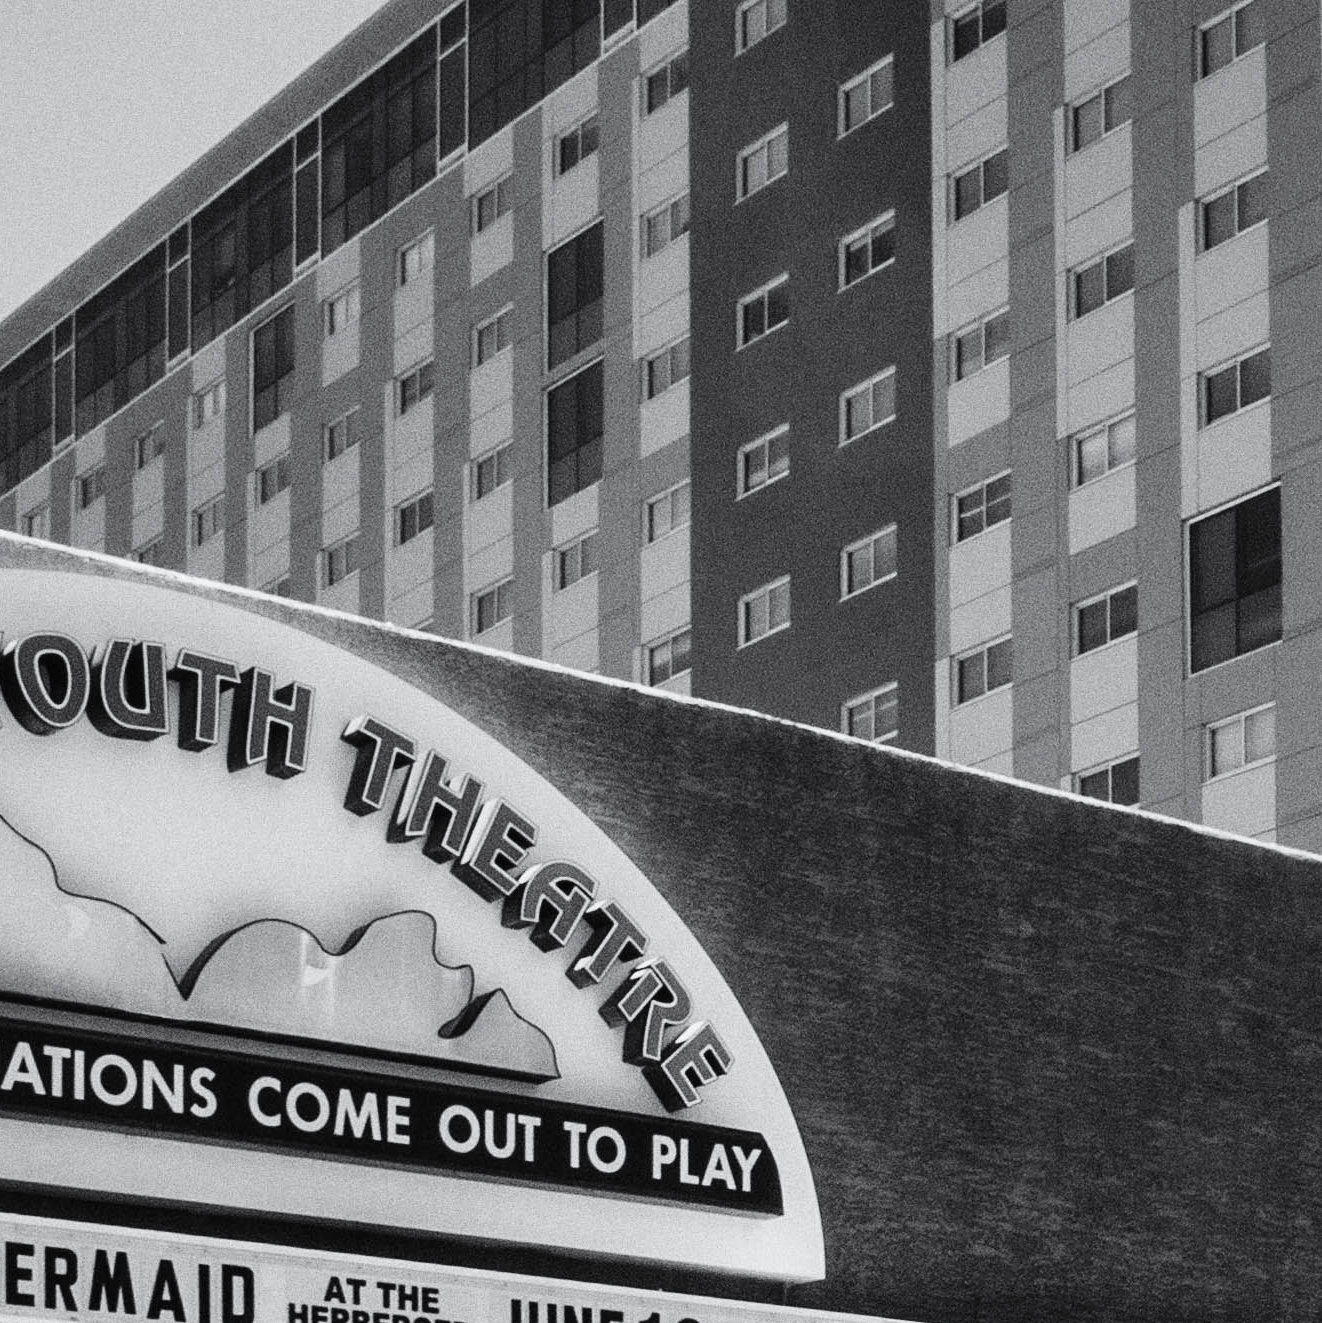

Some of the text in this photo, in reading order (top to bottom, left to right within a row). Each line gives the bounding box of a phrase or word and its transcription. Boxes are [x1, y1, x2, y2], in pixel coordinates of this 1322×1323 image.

[343, 715, 734, 1112] THEATRE
[248, 1077, 411, 1145] COME
[439, 1105, 541, 1163] OUT
[564, 1121, 626, 1174] TO
[652, 1133, 762, 1192] PLAY
[323, 1275, 440, 1314] AT THE
